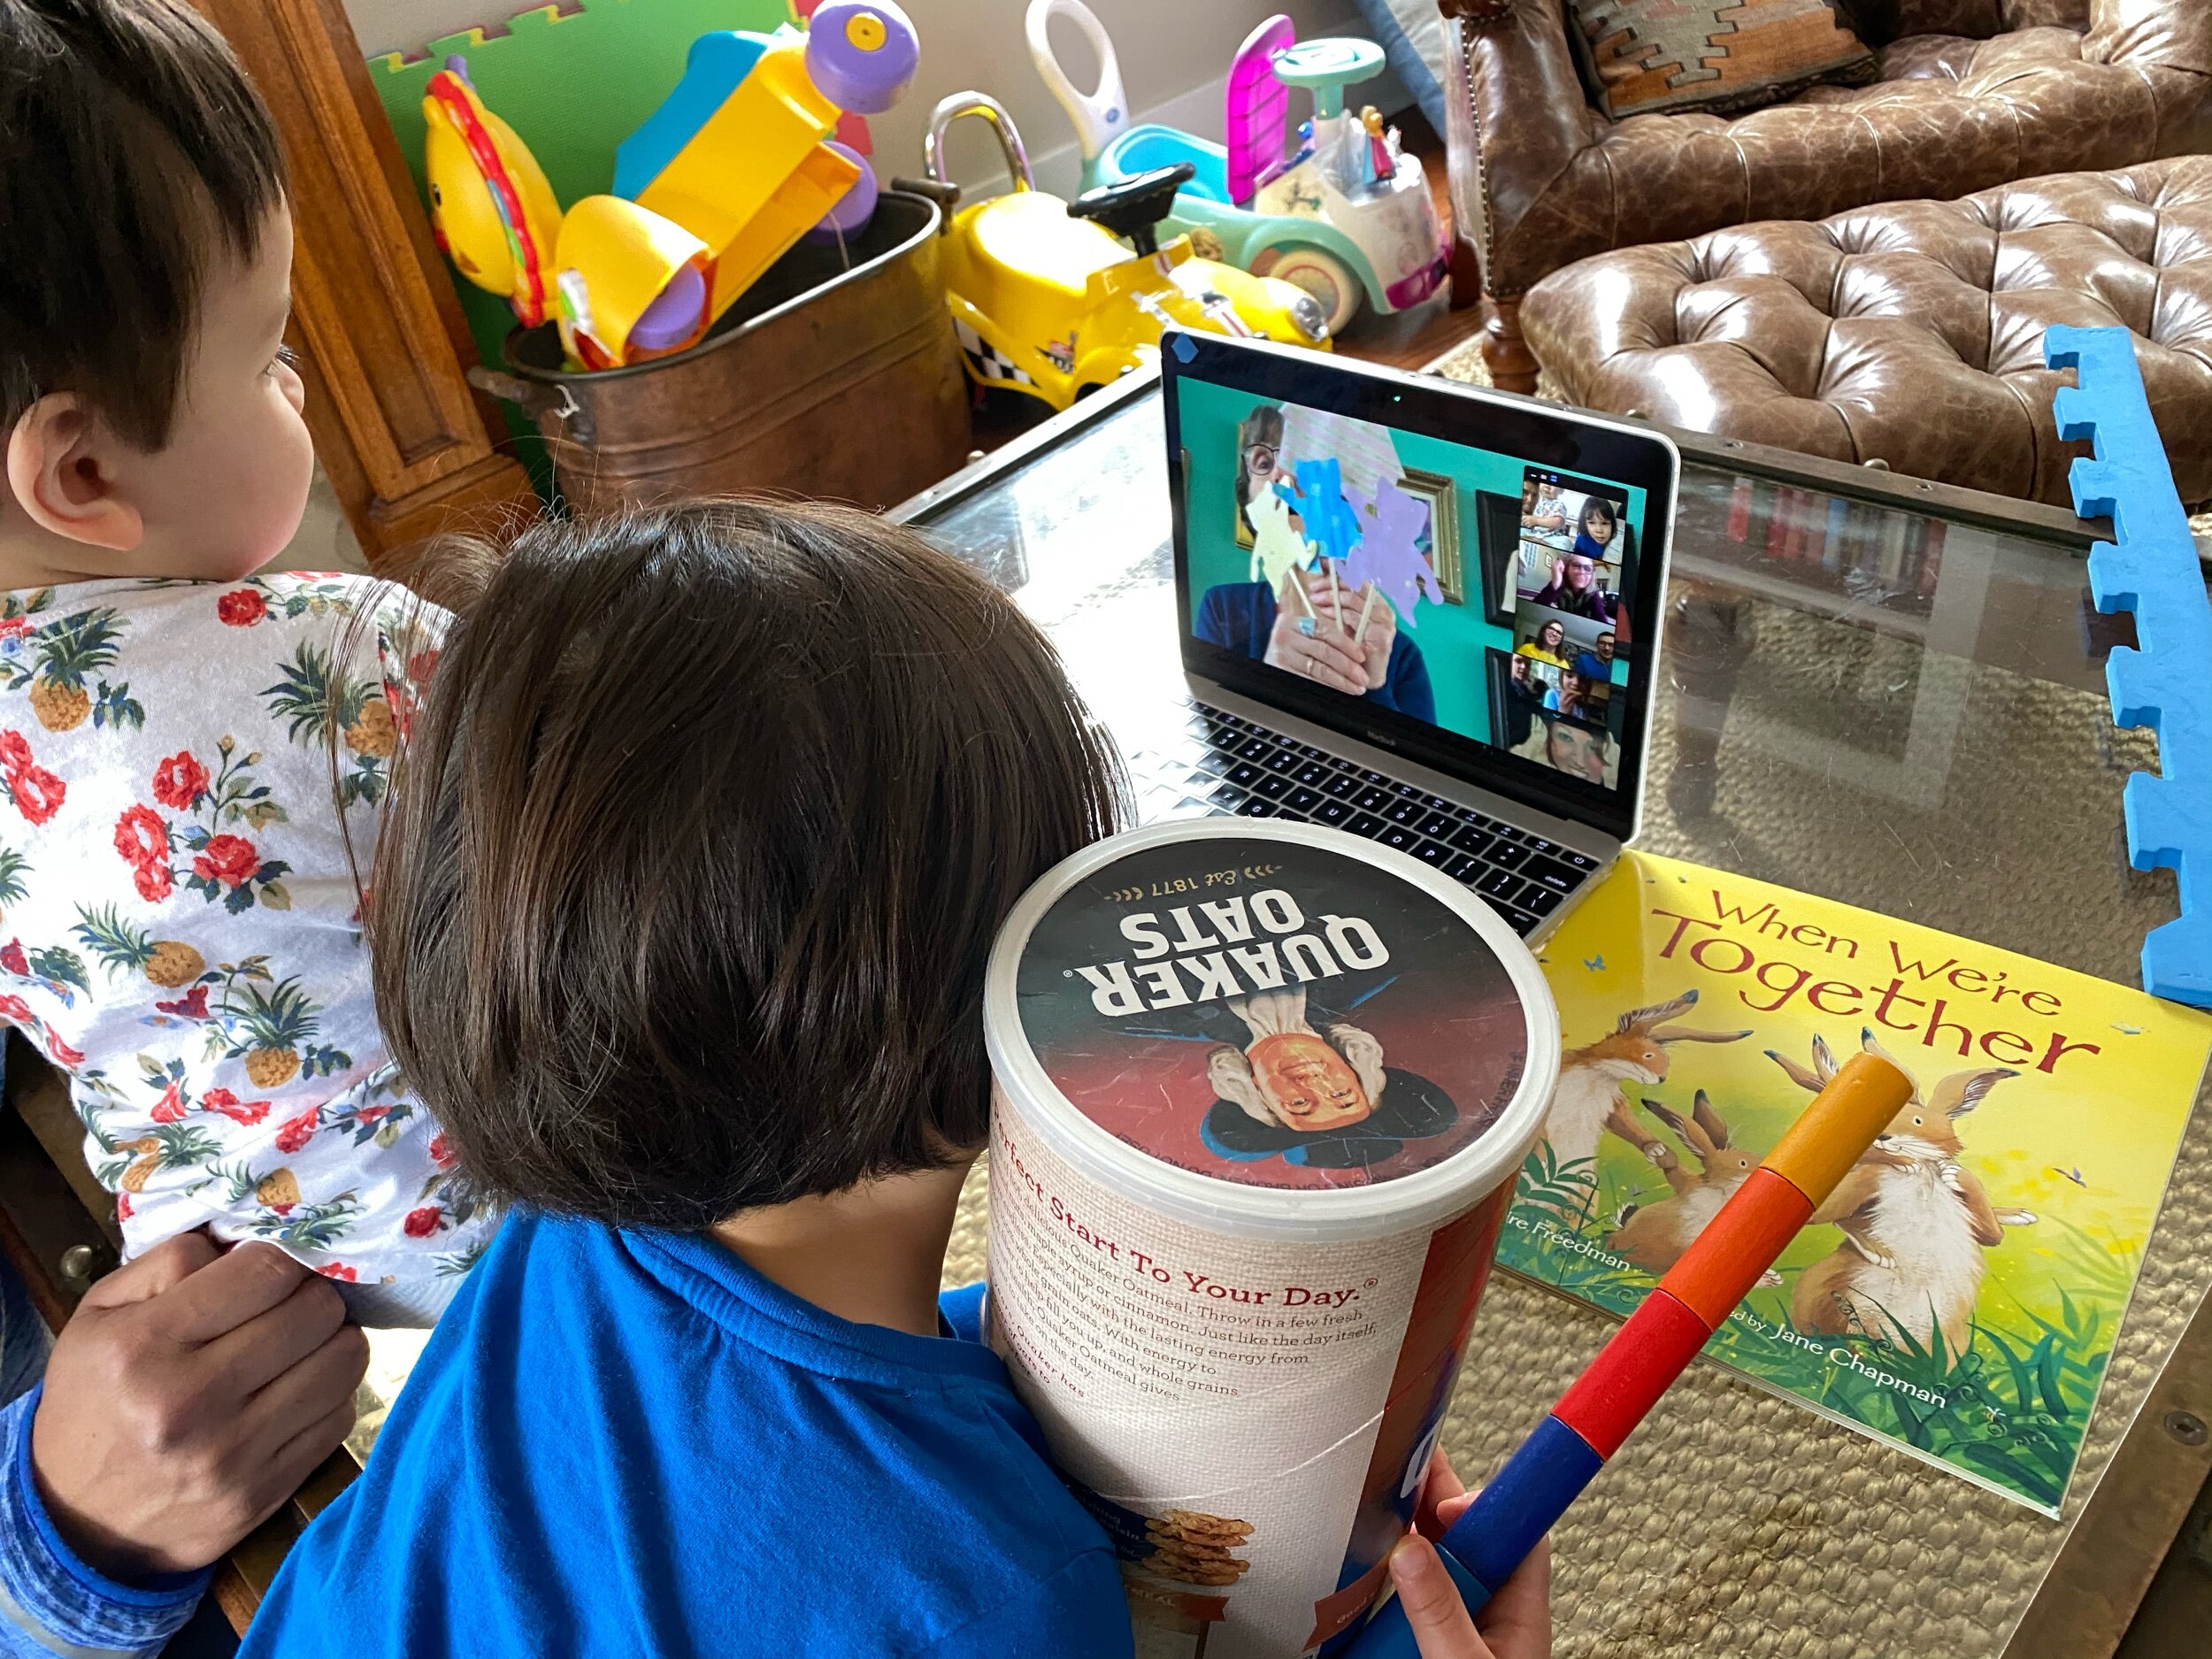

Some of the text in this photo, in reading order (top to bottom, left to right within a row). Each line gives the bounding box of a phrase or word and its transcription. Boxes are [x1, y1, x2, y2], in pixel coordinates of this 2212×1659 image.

[1118, 888, 1305, 959] OATS
[1152, 869, 1238, 896] Est 1877
[1544, 874, 1567, 887] delete
[1650, 908, 2101, 1074] Together
[1710, 889, 2062, 1018] When We're
[1024, 1194, 1066, 1248] delicious
[1070, 1243, 1118, 1284] Quaker
[1123, 1279, 1192, 1314] Oatmeal.
[1198, 1306, 1250, 1324] Throw
[1256, 1316, 1271, 1326] in
[1291, 1317, 1317, 1327] few
[1323, 1310, 1363, 1325] fresh
[1027, 1218, 1056, 1258] maple
[1059, 1255, 1093, 1288] syrup
[1096, 1285, 1110, 1297] or
[1114, 1294, 1194, 1334] cinnamon.
[1198, 1326, 1233, 1341] Just
[1239, 1333, 1267, 1345] like
[1273, 1336, 1298, 1346] the
[1303, 1334, 1332, 1346] day
[1335, 1322, 1377, 1341] itself,
[1049, 1195, 1119, 1262] Start
[1130, 1249, 1171, 1283] To
[1183, 1271, 1271, 1305] Your
[1532, 1221, 1631, 1271] Freedman
[1016, 1238, 1039, 1279] whole
[1041, 1274, 1069, 1309] grain
[1072, 1303, 1100, 1329] oats.
[1106, 1325, 1139, 1351] With
[1143, 1347, 1197, 1371] energy
[1201, 1363, 1216, 1375] to
[1017, 1294, 1033, 1326] take
[1035, 1324, 1048, 1340] on
[1049, 1337, 1067, 1358] the
[1070, 1356, 1094, 1381] day.
[1025, 1271, 1043, 1303] help
[1046, 1297, 1059, 1316] fill
[1062, 1314, 1085, 1340] you
[1087, 1336, 1105, 1352] up,
[1110, 1348, 1135, 1366] and
[1140, 1362, 1183, 1384] whole
[1187, 1380, 1239, 1396] grains
[1033, 1245, 1087, 1304] Especially
[1090, 1298, 1118, 1320] with
[1124, 1317, 1147, 1335] the
[1151, 1328, 1204, 1356] lasting
[1209, 1348, 1266, 1365] energy
[1271, 1353, 1309, 1363] from
[1037, 1305, 1076, 1349] Quaker
[1079, 1346, 1136, 1385] Oatmeal
[1140, 1381, 1180, 1401] gives
[1017, 1321, 1057, 1379] Quaker
[1060, 1373, 1084, 1399] has
[1017, 1340, 1036, 1371] oats
[1039, 1371, 1049, 1384] to
[1747, 1315, 1947, 1409] by Jane Chapman
